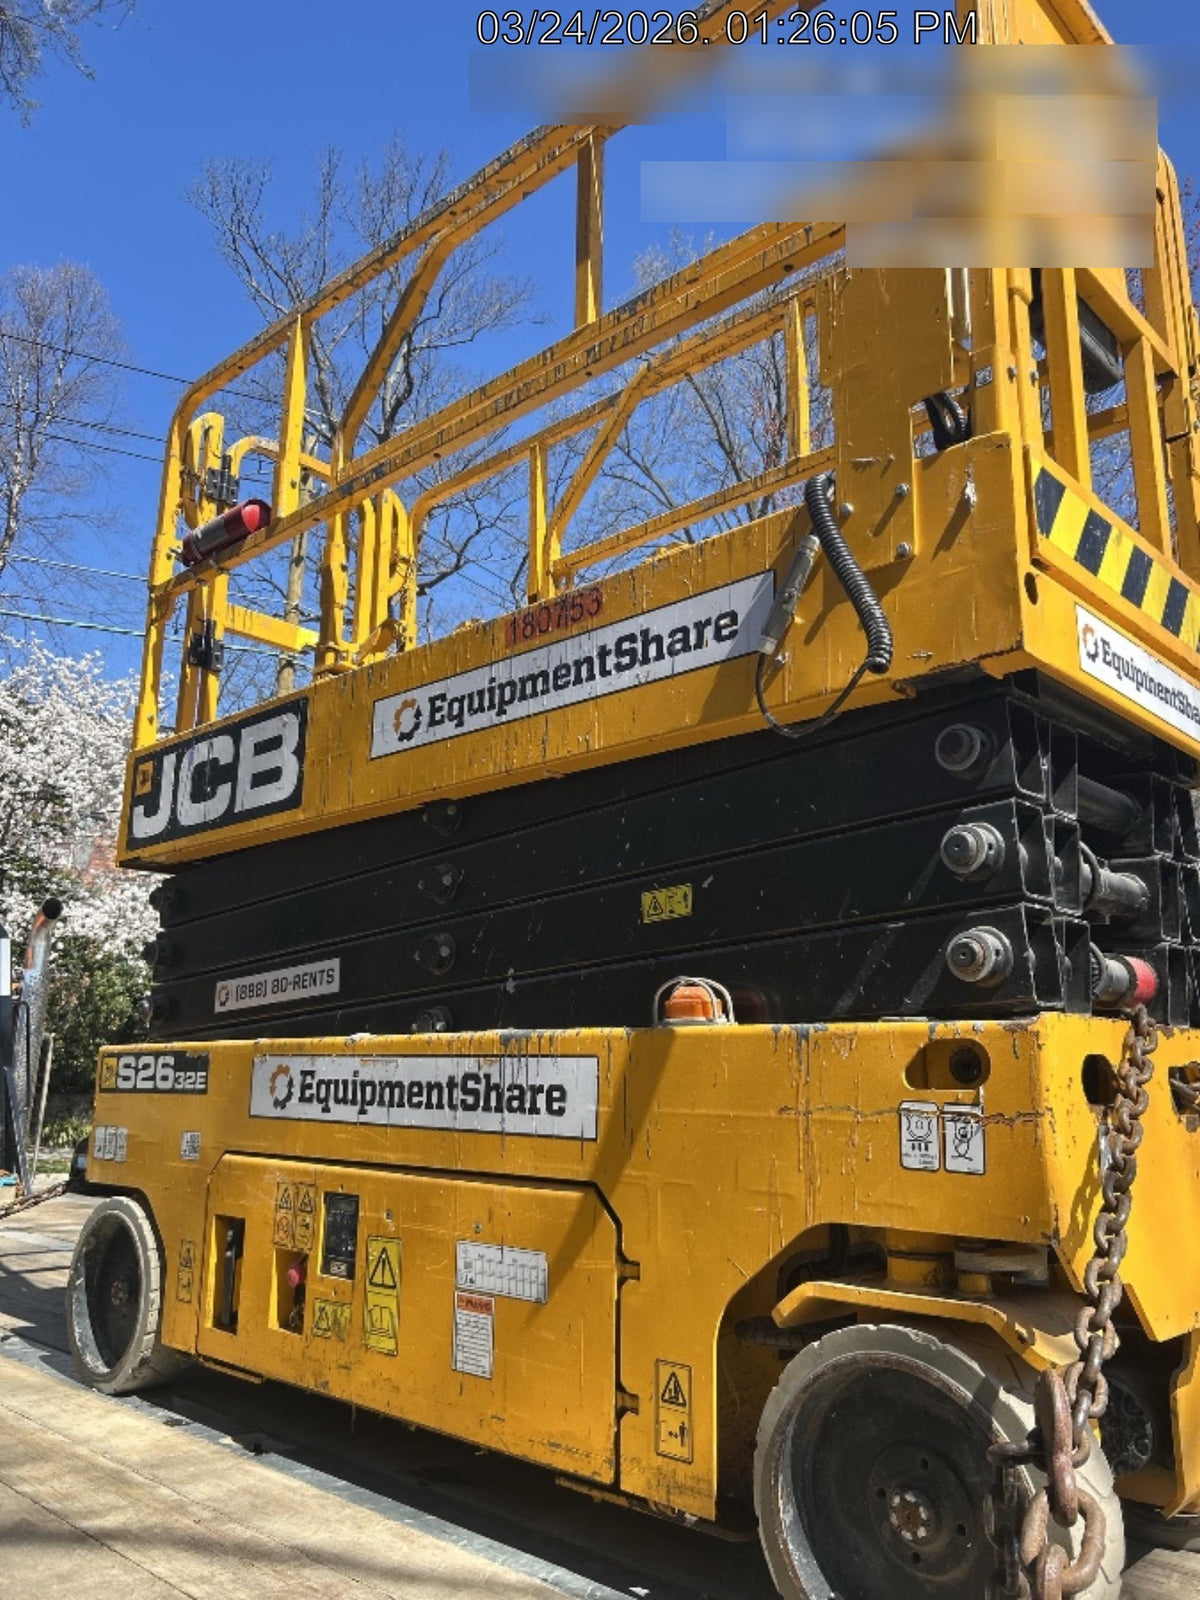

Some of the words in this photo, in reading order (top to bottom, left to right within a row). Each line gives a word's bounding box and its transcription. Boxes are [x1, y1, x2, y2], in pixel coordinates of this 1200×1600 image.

[427, 608, 739, 729] EquipmentShare
[132, 712, 300, 838] JCB
[236, 979, 268, 1002] (888)
[117, 1055, 175, 1090] S26
[174, 1071, 207, 1090] 32E
[298, 1070, 567, 1117] EquipmentShare
